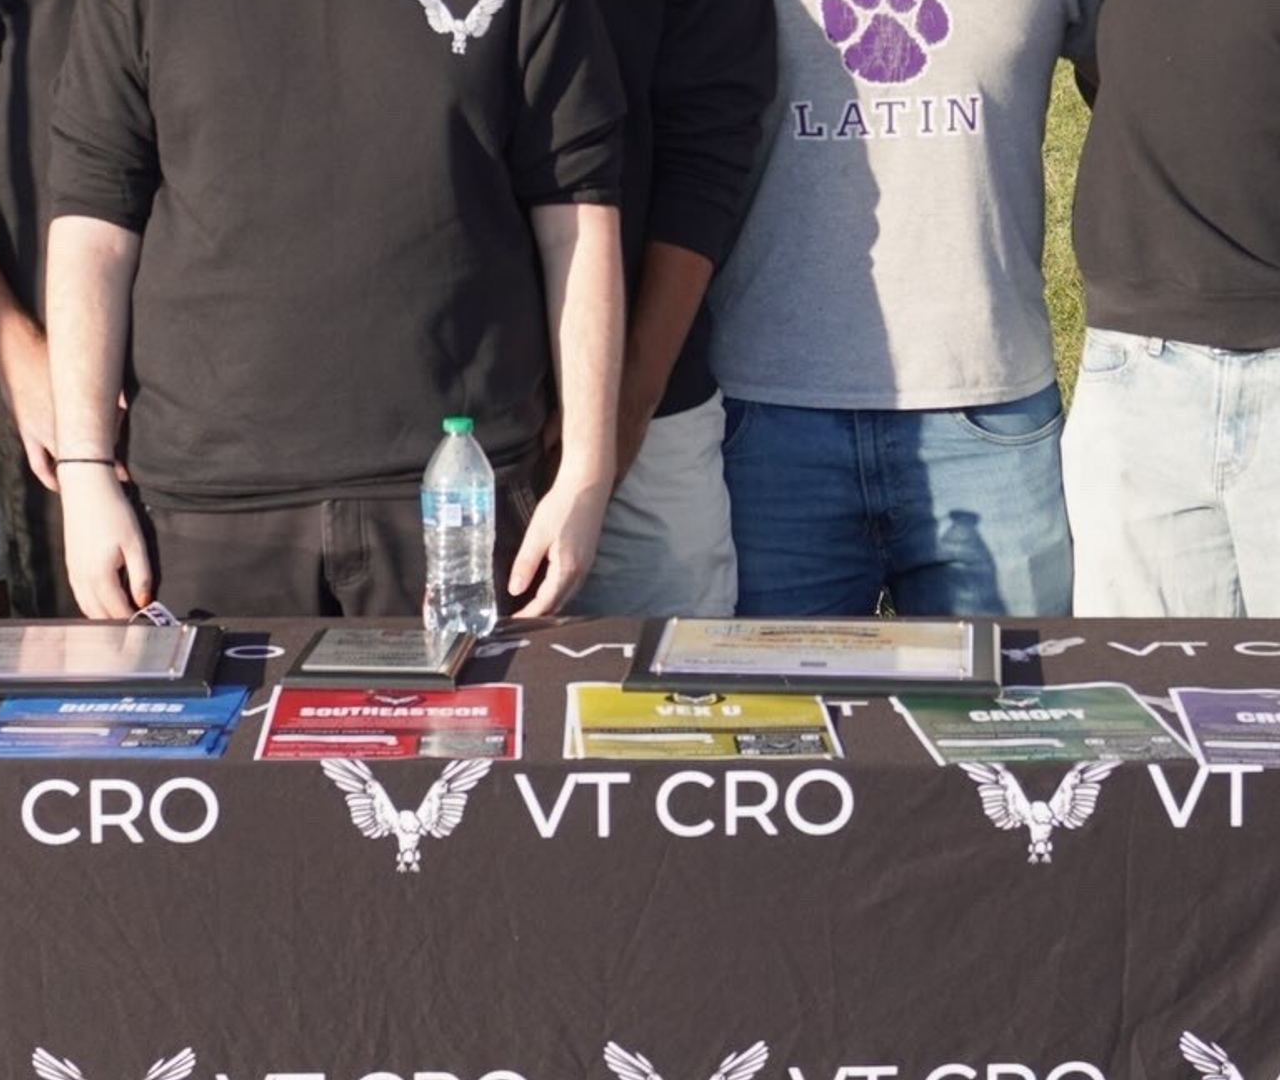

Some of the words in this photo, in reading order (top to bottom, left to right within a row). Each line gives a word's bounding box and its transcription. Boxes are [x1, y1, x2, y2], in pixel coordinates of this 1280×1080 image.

[794, 97, 980, 138] LATIN
[1107, 641, 1208, 657] VT
[59, 702, 185, 714] BUSINESS
[299, 706, 489, 718] SOUTHEASTCON
[656, 704, 712, 718] VEX
[720, 704, 743, 717] U
[969, 707, 1086, 724] CANOPY
[515, 773, 632, 839] VT
[655, 769, 855, 838] CRO
[1148, 764, 1265, 829] VT
[21, 778, 220, 846] CRO
